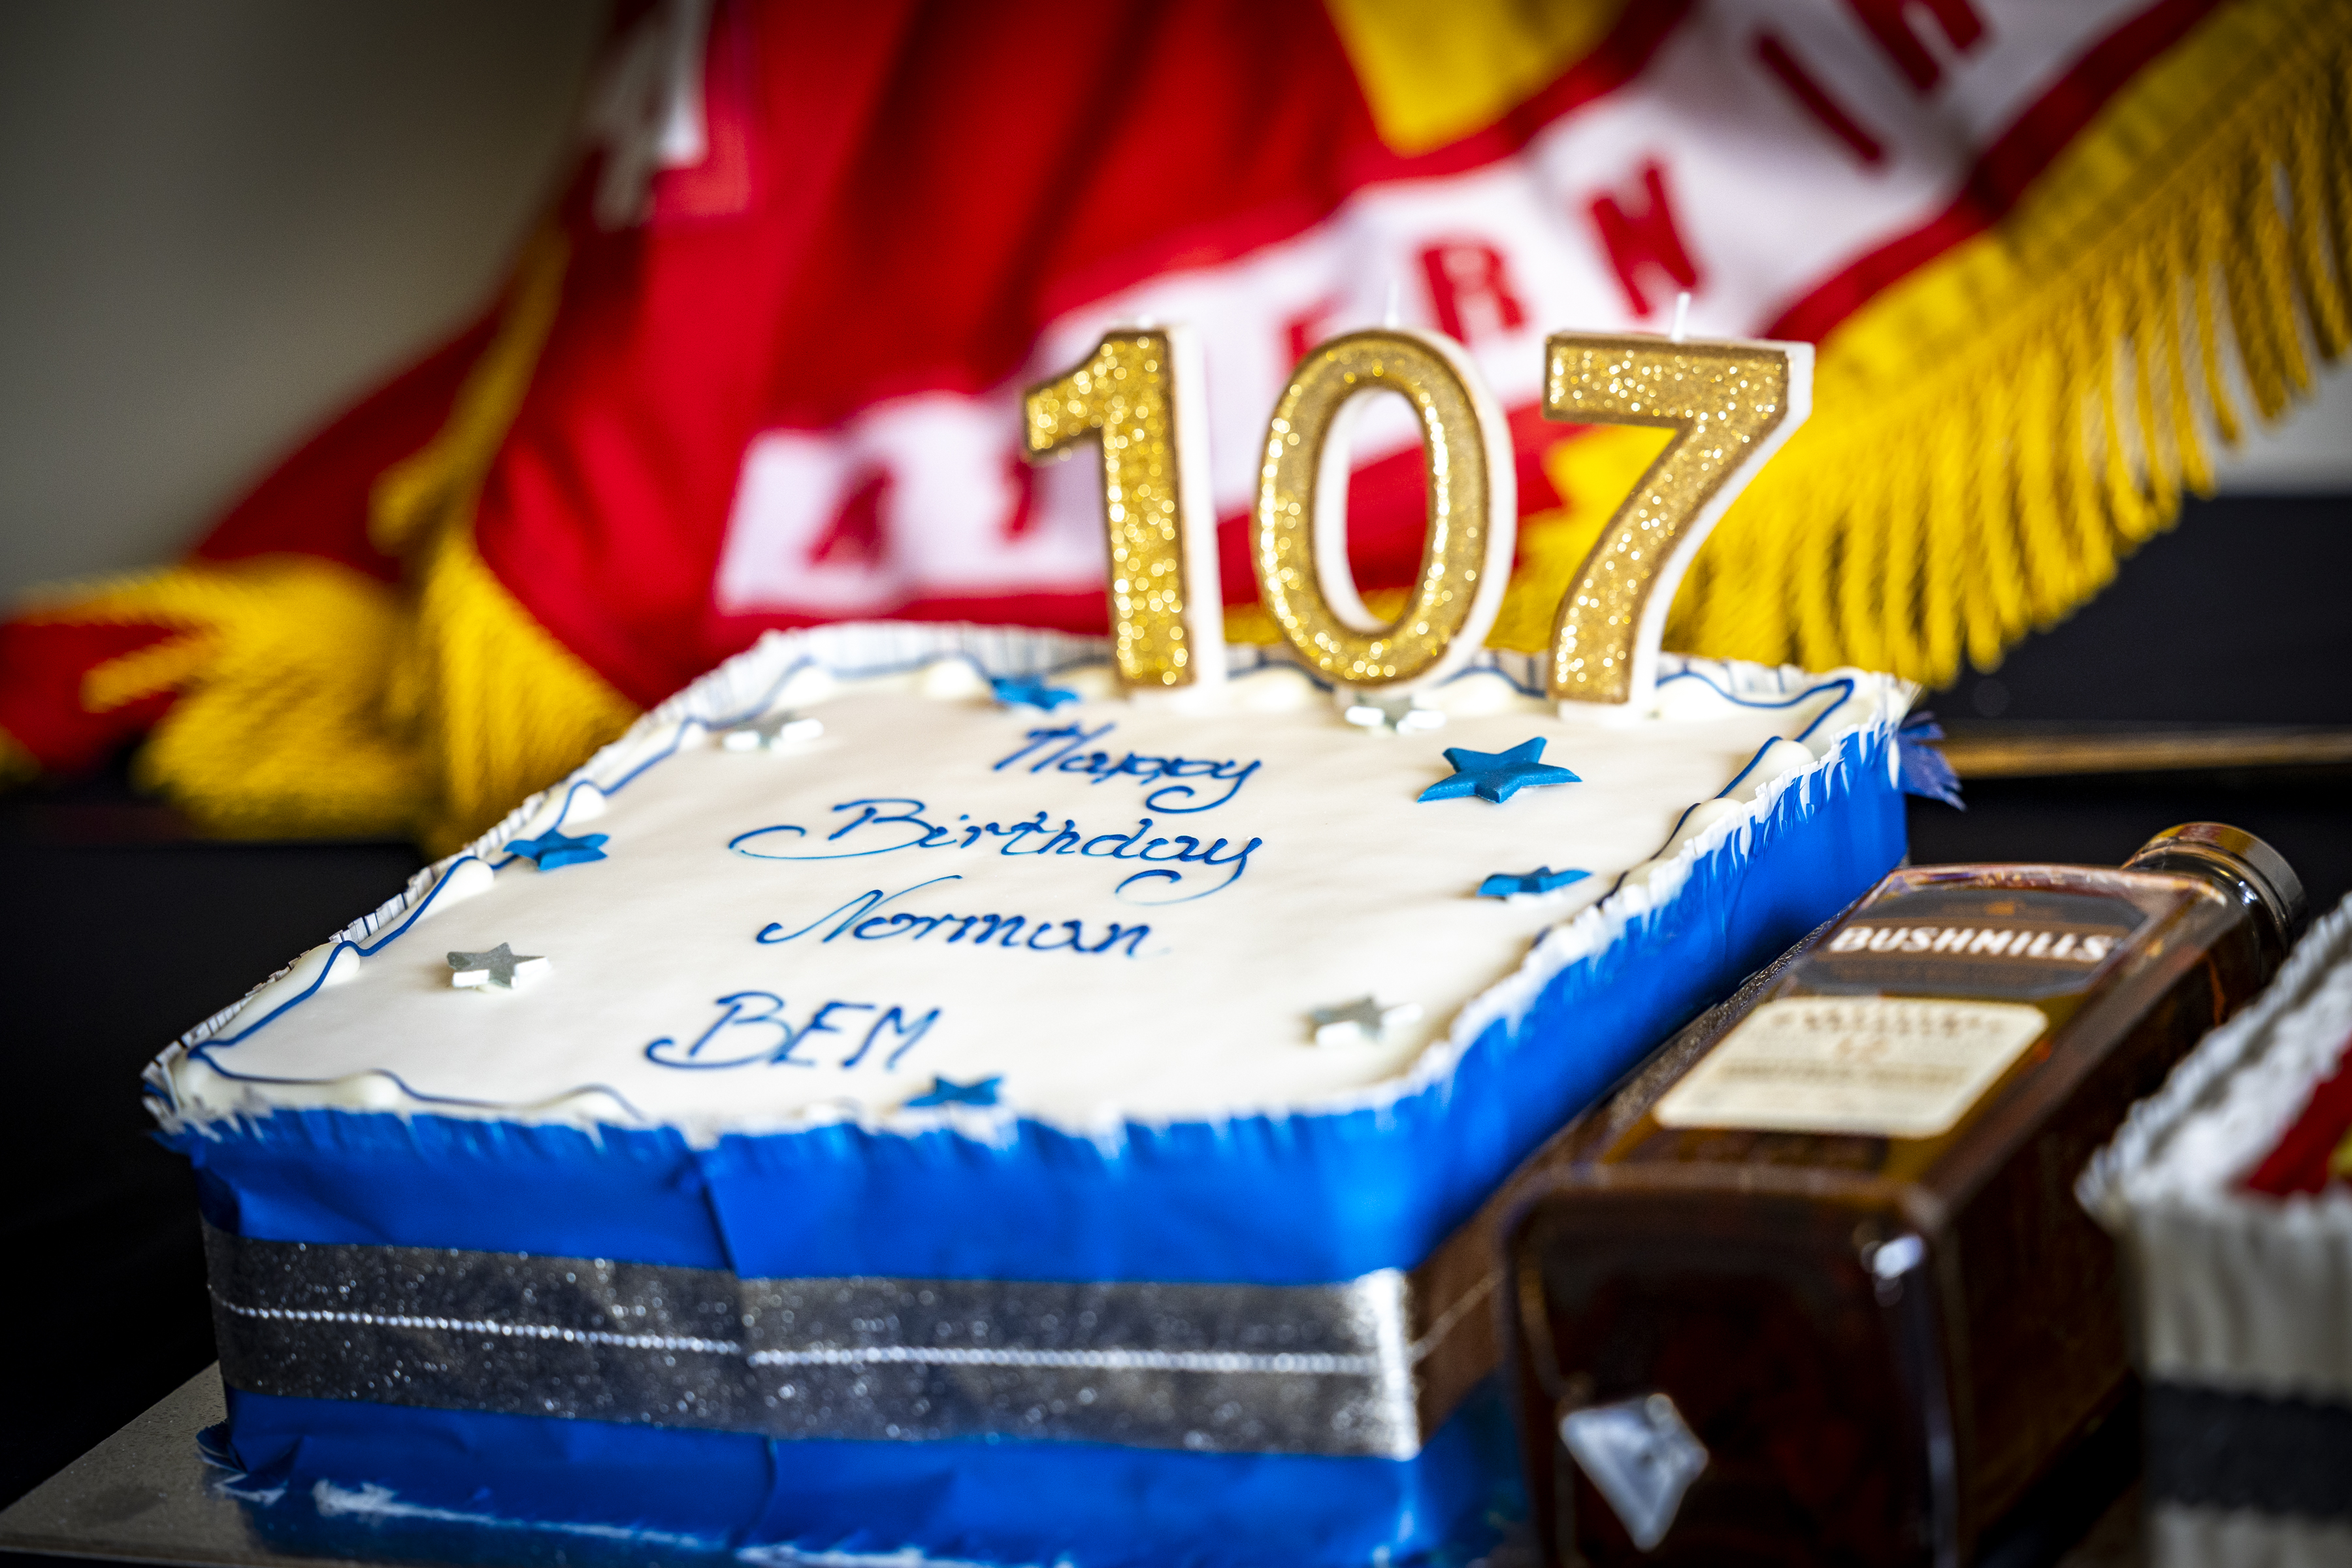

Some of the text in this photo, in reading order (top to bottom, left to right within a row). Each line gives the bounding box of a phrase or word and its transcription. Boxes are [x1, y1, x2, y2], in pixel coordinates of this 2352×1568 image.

[1024, 324, 1815, 707] 107
[991, 721, 1262, 815] Happy
[728, 798, 1264, 906] Birthday
[755, 874, 1160, 958] Norman
[1829, 925, 2115, 963] BUSHMILLS
[644, 990, 942, 1071] BEM
